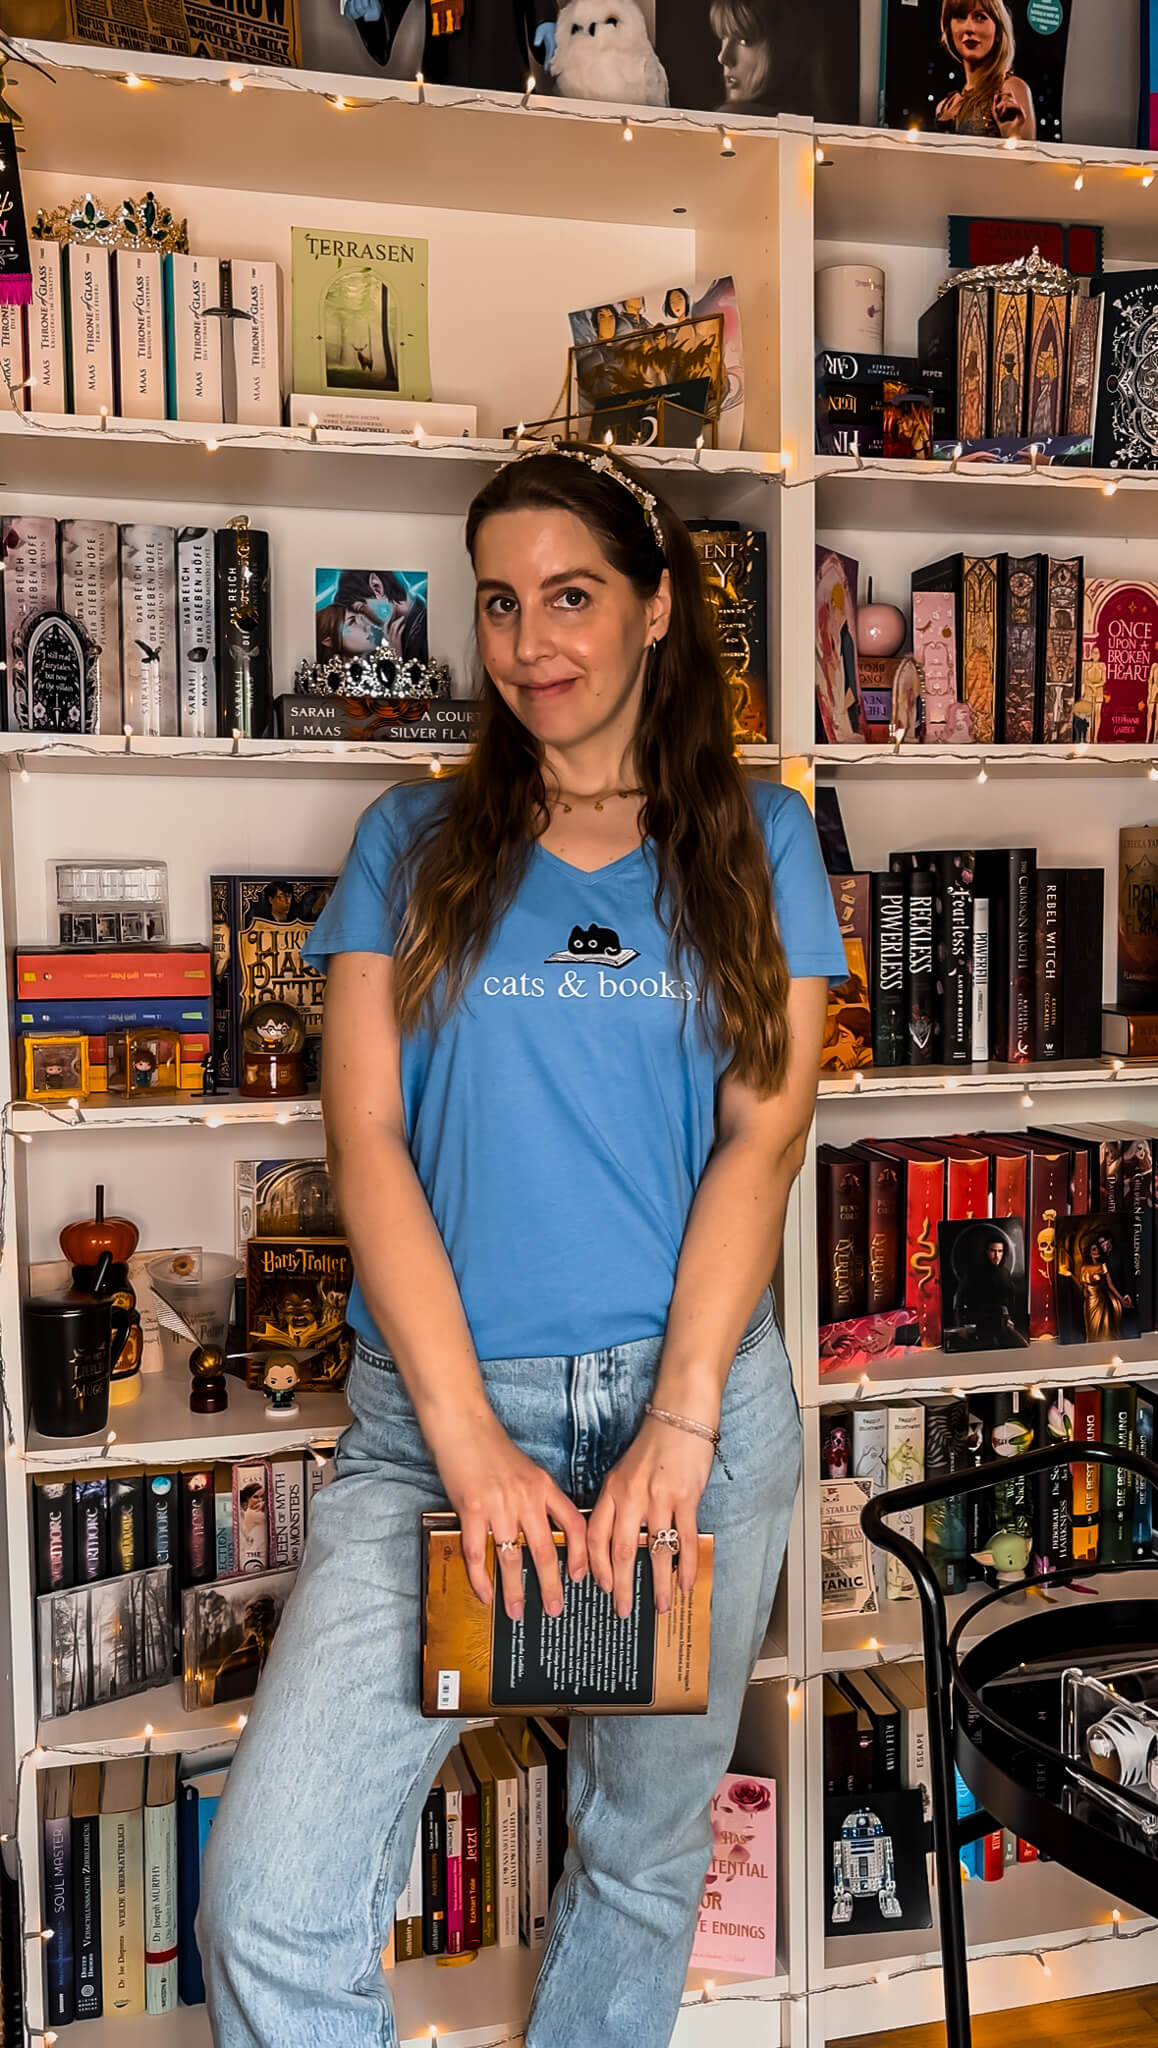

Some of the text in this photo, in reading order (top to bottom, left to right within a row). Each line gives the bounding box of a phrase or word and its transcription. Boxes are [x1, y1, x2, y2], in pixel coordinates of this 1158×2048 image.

[186, 13, 238, 40] MUGGLE
[241, 30, 290, 56] FAMILY
[190, 27, 291, 66] MURDERED
[306, 237, 415, 264] TERRASEN
[38, 265, 48, 297] GLASS
[83, 271, 93, 302] GLASS
[135, 275, 145, 306] GLASS
[191, 280, 201, 310] GLASS
[249, 285, 260, 316] GLASS
[41, 306, 50, 350] THRONE
[85, 311, 95, 355] THRONE
[137, 316, 146, 360] THRONE
[193, 320, 203, 361] THRONE
[250, 326, 260, 367] THRONE
[43, 359, 51, 386] MAAS
[88, 364, 96, 391] MAAS
[138, 368, 148, 395] MAAS
[195, 371, 203, 398] MAAS
[922, 369, 943, 378] PIPER
[193, 545, 203, 573] HÖFE
[700, 543, 738, 560] ENT
[16, 557, 25, 594] REICH
[29, 569, 38, 613] SIEBEN
[75, 560, 84, 597] REICH
[134, 565, 142, 602] REICH
[181, 567, 190, 605] REICH
[228, 567, 238, 602] REICH
[88, 574, 97, 616] SIEBEN
[147, 578, 156, 620] SIEBEN
[195, 583, 203, 622] SIEBEN
[1108, 619, 1152, 640] ONCE
[1108, 638, 1150, 651] UPON A
[1107, 650, 1151, 664] BROKEN
[1107, 663, 1150, 682] HEART
[188, 680, 197, 716] SARAH
[201, 675, 209, 707] MAAS
[290, 706, 335, 719] SARAH
[421, 711, 432, 722] A
[291, 725, 341, 737] J. MAAS
[390, 727, 437, 739] SILVER
[1018, 875, 1029, 928] CRIMSON
[909, 896, 932, 974] RECKLESS
[947, 886, 973, 957] Fearless
[1045, 884, 1057, 980] REBEL WITCH
[880, 894, 904, 991] POWERLESS
[1017, 931, 1030, 969] MOTH
[483, 971, 545, 997] cats
[557, 970, 589, 998] &
[956, 1007, 964, 1043] ROBERTS
[1133, 1223, 1143, 1253] FALLEN
[261, 1248, 346, 1274] Barry Trotter
[276, 1472, 286, 1510] MYTH
[1086, 1493, 1095, 1511] DIE
[1117, 1490, 1126, 1507] DIE
[289, 1484, 300, 1562] AND MONSTERS
[825, 1505, 845, 1514] STAR
[1052, 1484, 1060, 1550] DEBORAH Die
[1059, 1499, 1067, 1558] HARKNESS
[885, 1724, 895, 1746] ALEX
[915, 1733, 924, 1769] ESCAPE
[535, 1798, 543, 1825] GROW
[55, 1826, 64, 1878] MASTER
[535, 1838, 543, 1864] THINK
[55, 1880, 65, 1913] SOUL
[151, 1864, 161, 1902] MURPHY
[117, 1897, 127, 1928] WERDE
[151, 1903, 162, 1929] Joseph
[469, 1895, 478, 1924] Eckhart
[431, 1921, 440, 1950] ullstein
[711, 1920, 766, 1940] ENDINGS
